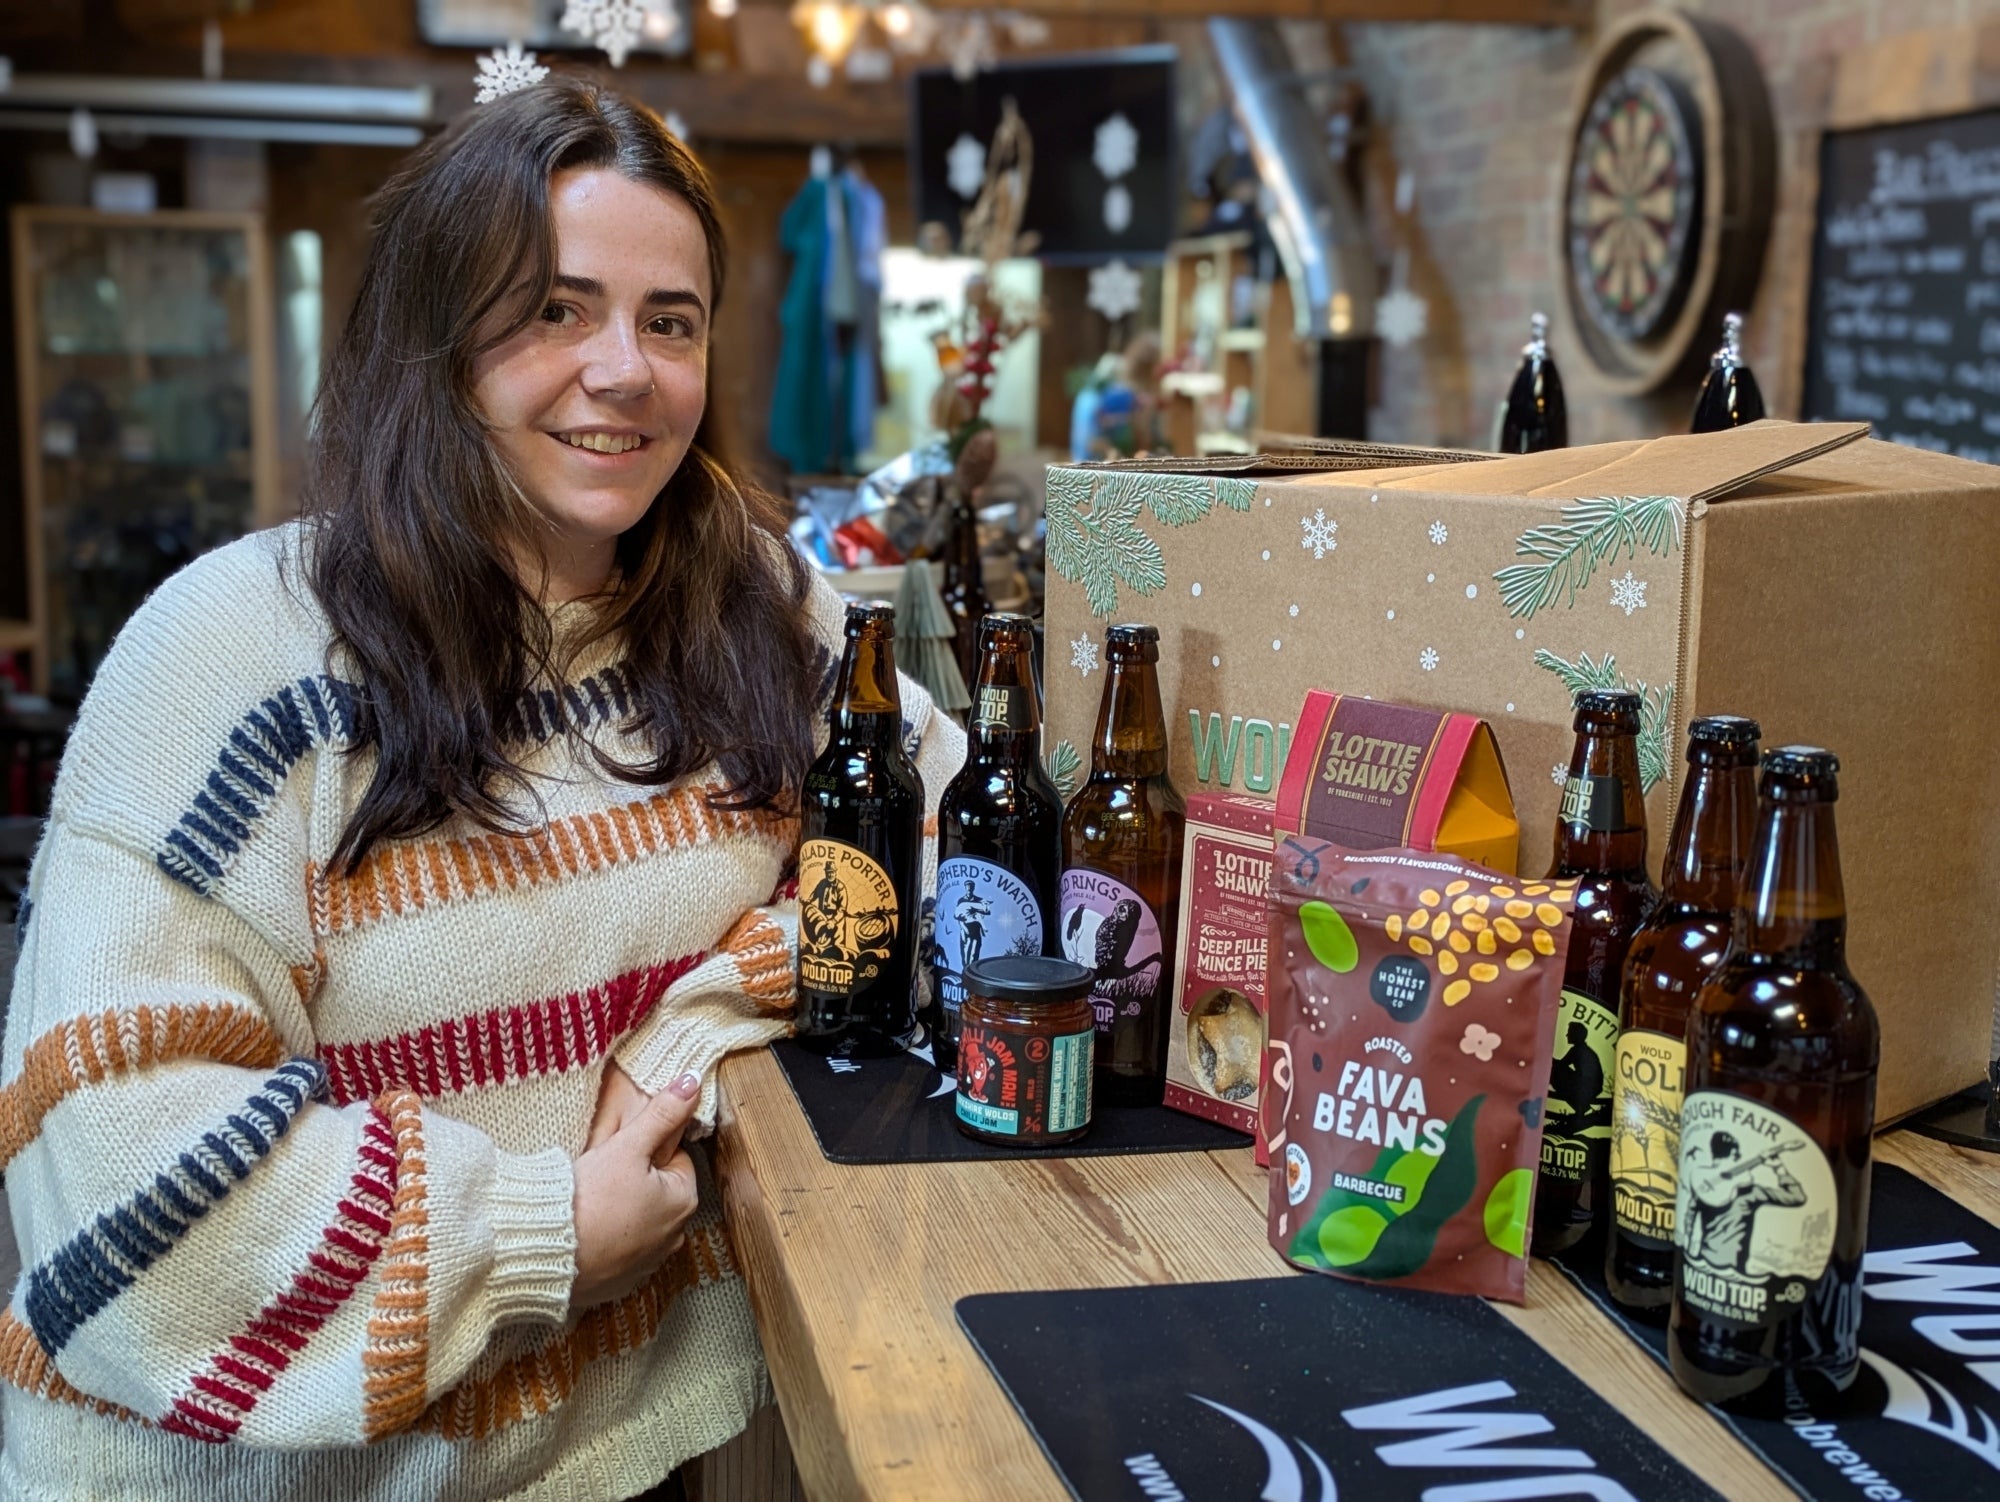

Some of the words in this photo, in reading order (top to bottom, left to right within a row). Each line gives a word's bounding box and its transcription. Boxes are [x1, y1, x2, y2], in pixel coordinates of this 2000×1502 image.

[980, 687, 1009, 702] WOLD
[979, 700, 1008, 721] TOP.
[1329, 731, 1422, 771] LOTTIE
[1327, 787, 1335, 795] OF
[1335, 788, 1364, 802] YORKSHIRE
[1565, 776, 1594, 796] WOLD
[1562, 791, 1592, 819] TOP.
[840, 850, 891, 902] PORTER
[1343, 855, 1397, 864] DELICIOUSLY
[1397, 857, 1463, 875] FLAVOURSOME
[1465, 869, 1503, 884] SNACKS
[996, 874, 1038, 928] WATCH
[1071, 875, 1121, 901] RINGS
[1199, 936, 1233, 955] DEEP
[1234, 938, 1268, 955] FILLE
[802, 961, 828, 982] WOLD
[1197, 951, 1243, 972] MINCE
[1245, 954, 1267, 971] PIE
[1395, 966, 1413, 977] THE
[1379, 971, 1425, 991] HONEST
[1386, 985, 1415, 1002] BEAN
[1094, 1005, 1114, 1023] OP.
[1572, 1002, 1618, 1049] BITT
[986, 1035, 1016, 1067] JAM
[1031, 1040, 1044, 1059] 2
[1364, 1036, 1413, 1065] ROASTED
[1641, 1044, 1672, 1061] WOLD
[1053, 1049, 1063, 1081] WOLDS
[1337, 1060, 1427, 1116] FAVA
[959, 1097, 982, 1116] KSHIRE
[984, 1107, 1015, 1121] WOLDS
[1050, 1082, 1062, 1131] YORKSHIRE
[979, 1114, 998, 1128] JAM
[1246, 1115, 1253, 1129] 2
[1313, 1092, 1448, 1157] BEANS
[1682, 1101, 1725, 1128] OUGH
[1731, 1105, 1781, 1143] FAIR
[1334, 1173, 1403, 1201] BARBECUE
[1615, 1190, 1653, 1225] WOLD
[1683, 1264, 1727, 1303] WOLD
